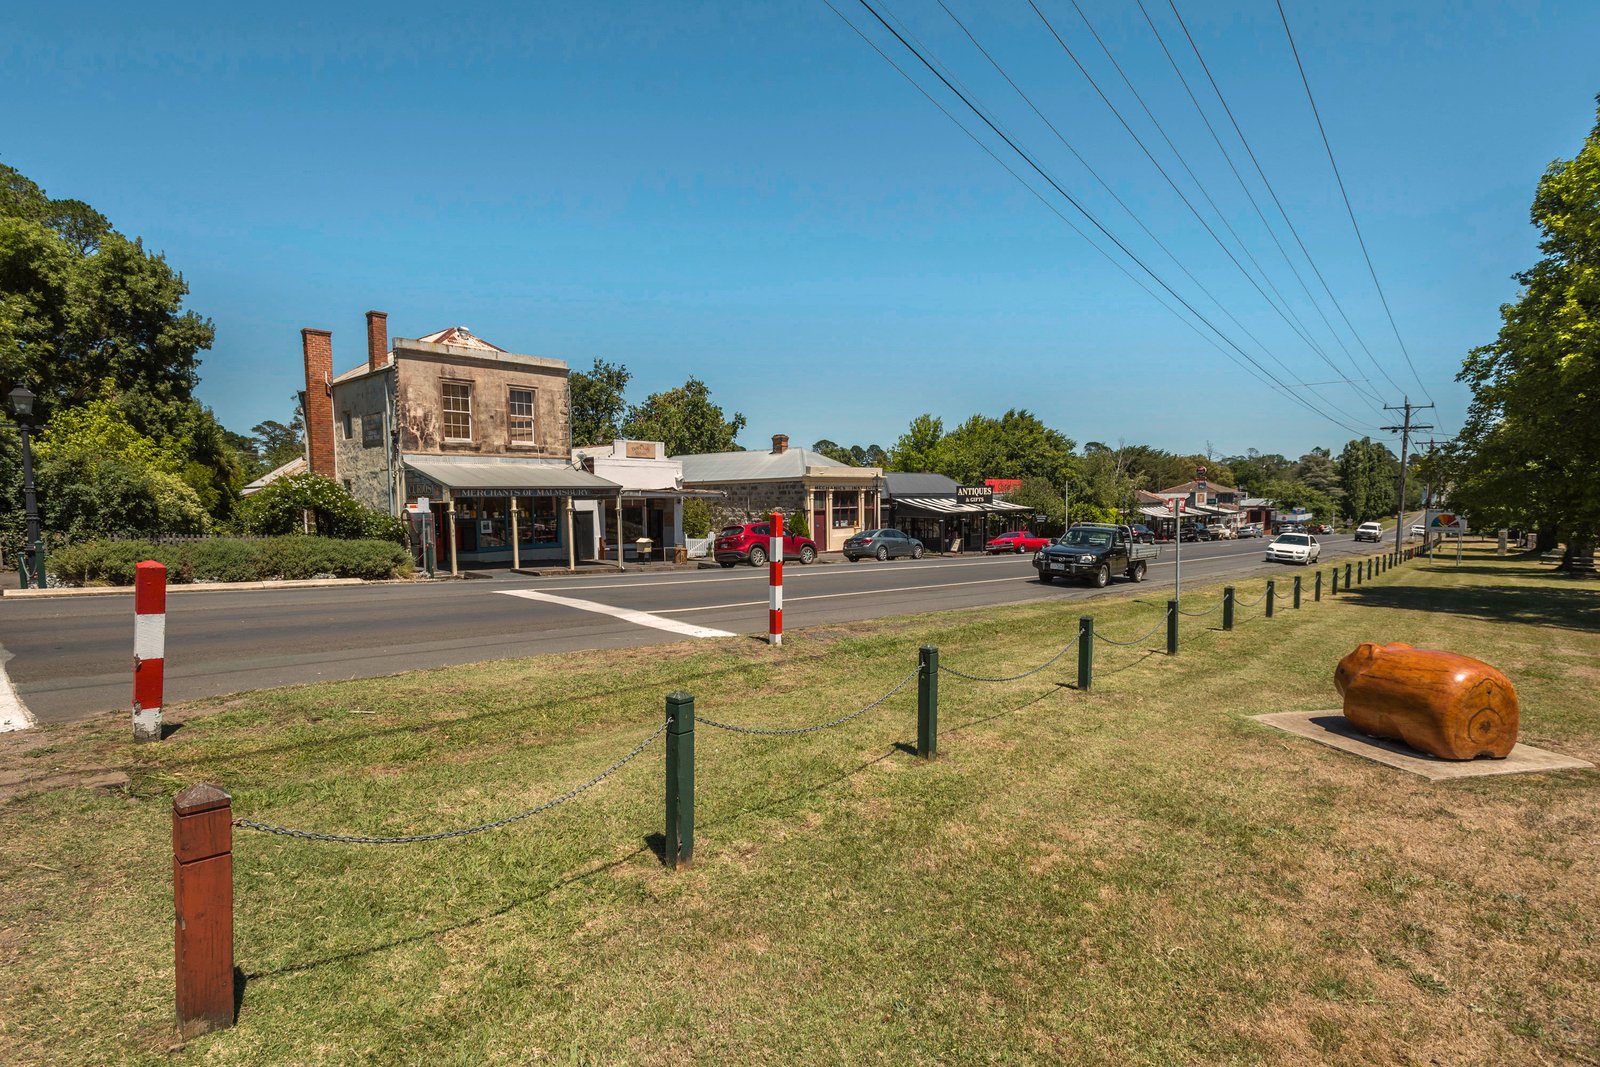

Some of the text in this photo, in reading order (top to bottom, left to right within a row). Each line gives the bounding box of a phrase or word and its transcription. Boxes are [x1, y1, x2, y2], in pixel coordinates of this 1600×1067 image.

[461, 489, 521, 497] MERCHANTS
[522, 489, 532, 497] OF
[957, 487, 992, 496] ANTIQUES
